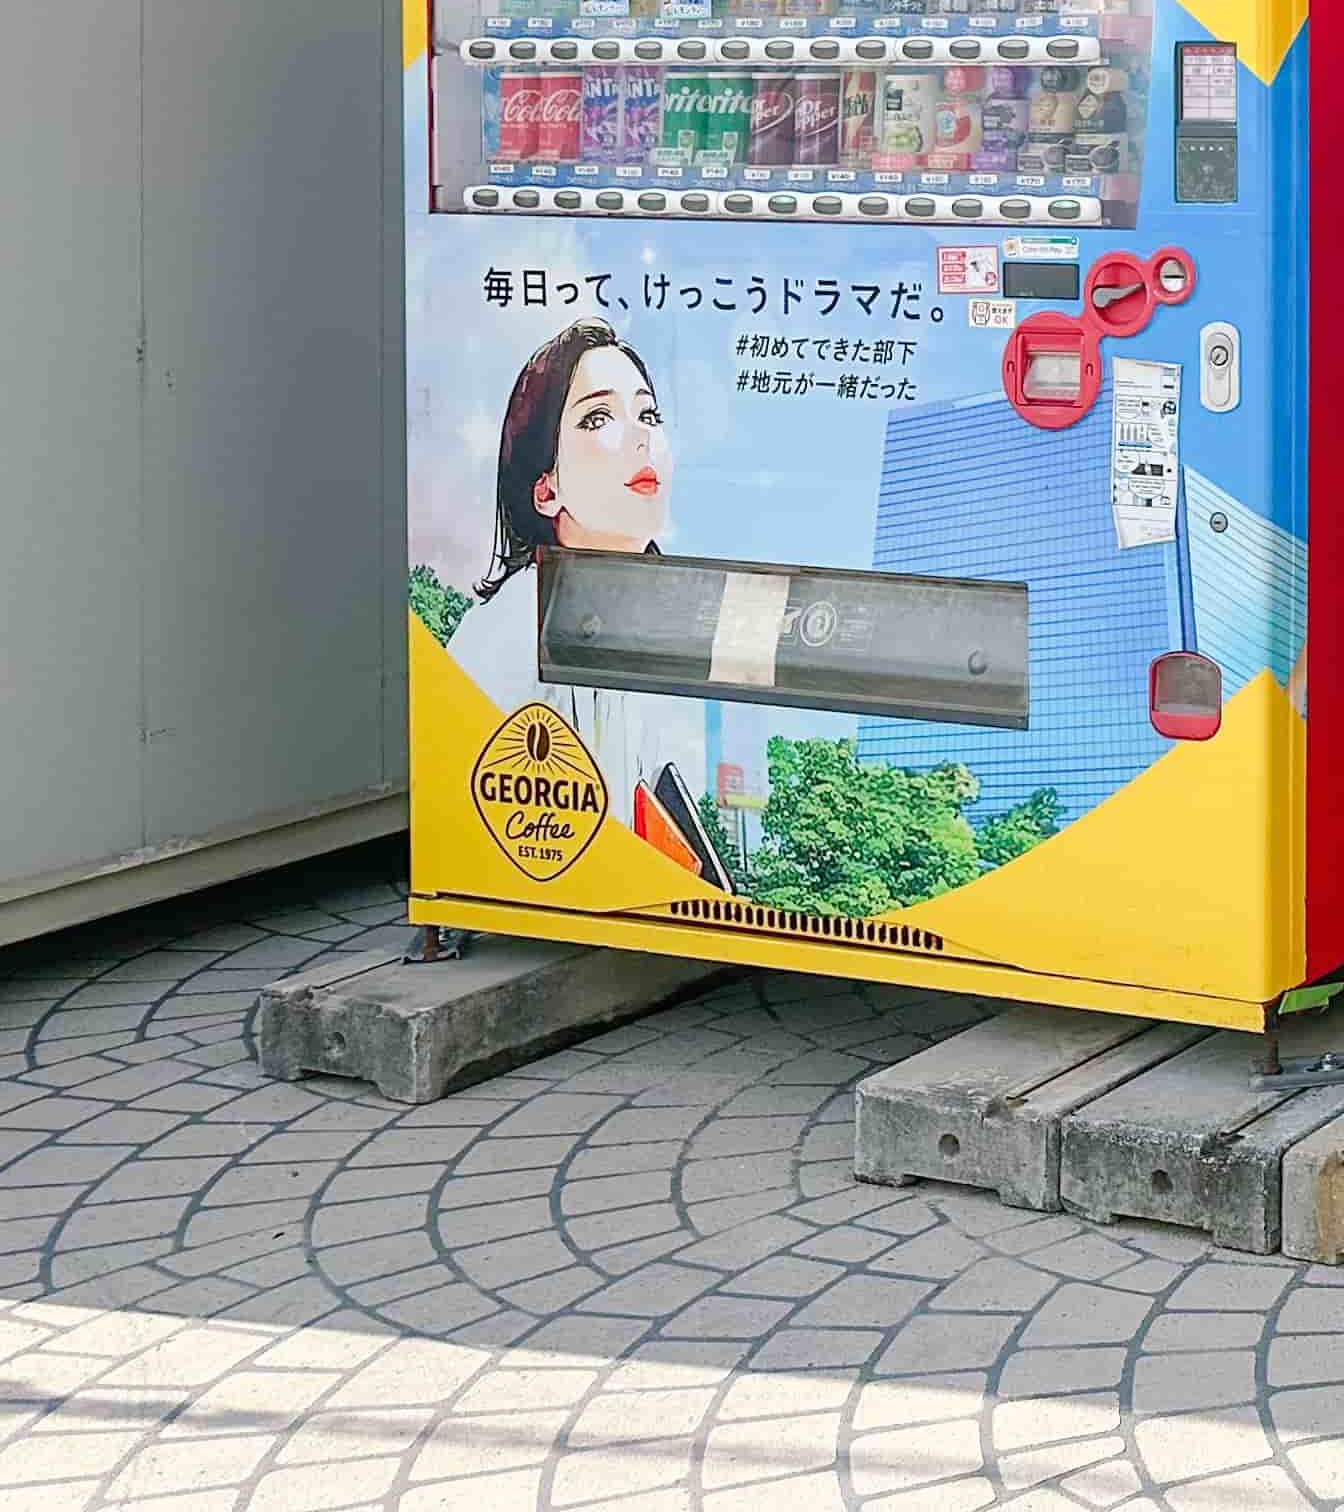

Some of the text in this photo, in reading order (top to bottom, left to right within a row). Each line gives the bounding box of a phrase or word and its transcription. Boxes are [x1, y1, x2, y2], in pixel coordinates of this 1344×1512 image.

[482, 266, 945, 324] 毎日って、けっこうドラマだ。
[736, 333, 918, 367] #初めてできた部下
[736, 369, 918, 402] #地元が一緒だった
[480, 772, 600, 814] GEORGIA
[505, 810, 575, 841] Coffee
[518, 845, 563, 862] EST. 1975
